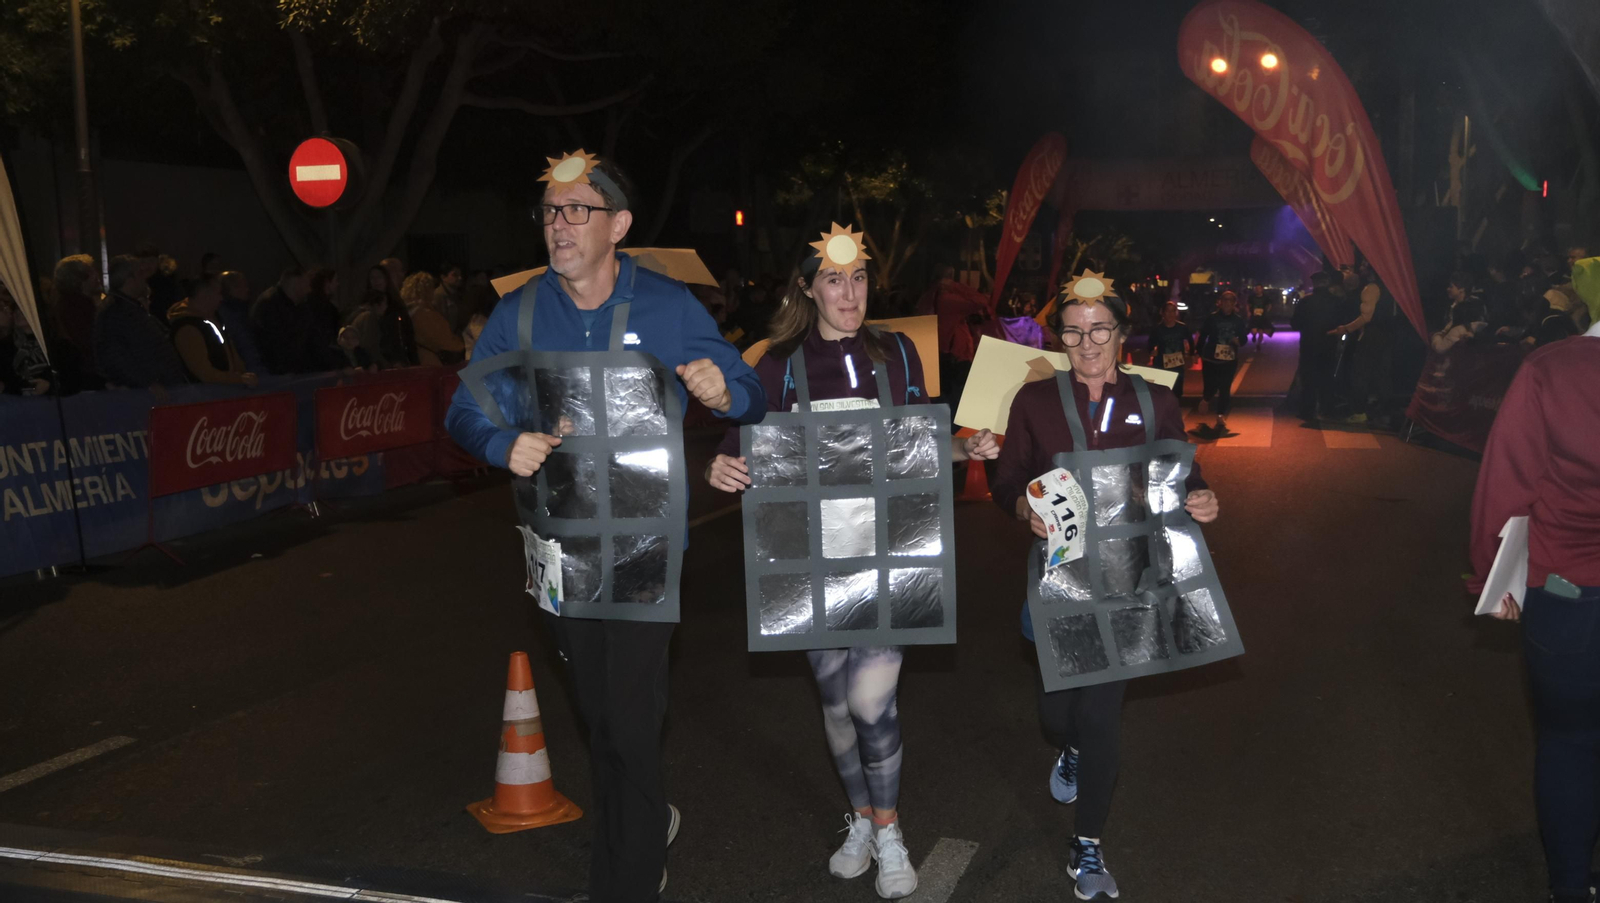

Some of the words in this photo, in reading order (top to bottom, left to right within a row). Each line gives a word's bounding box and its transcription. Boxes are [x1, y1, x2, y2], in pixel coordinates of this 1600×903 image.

[186, 411, 268, 468] Coca-Cola
[340, 392, 408, 440] Coca-Cola
[3, 467, 136, 521] ALMERÍA
[1051, 493, 1078, 541] 116
[1050, 510, 1062, 531] CARMEN
